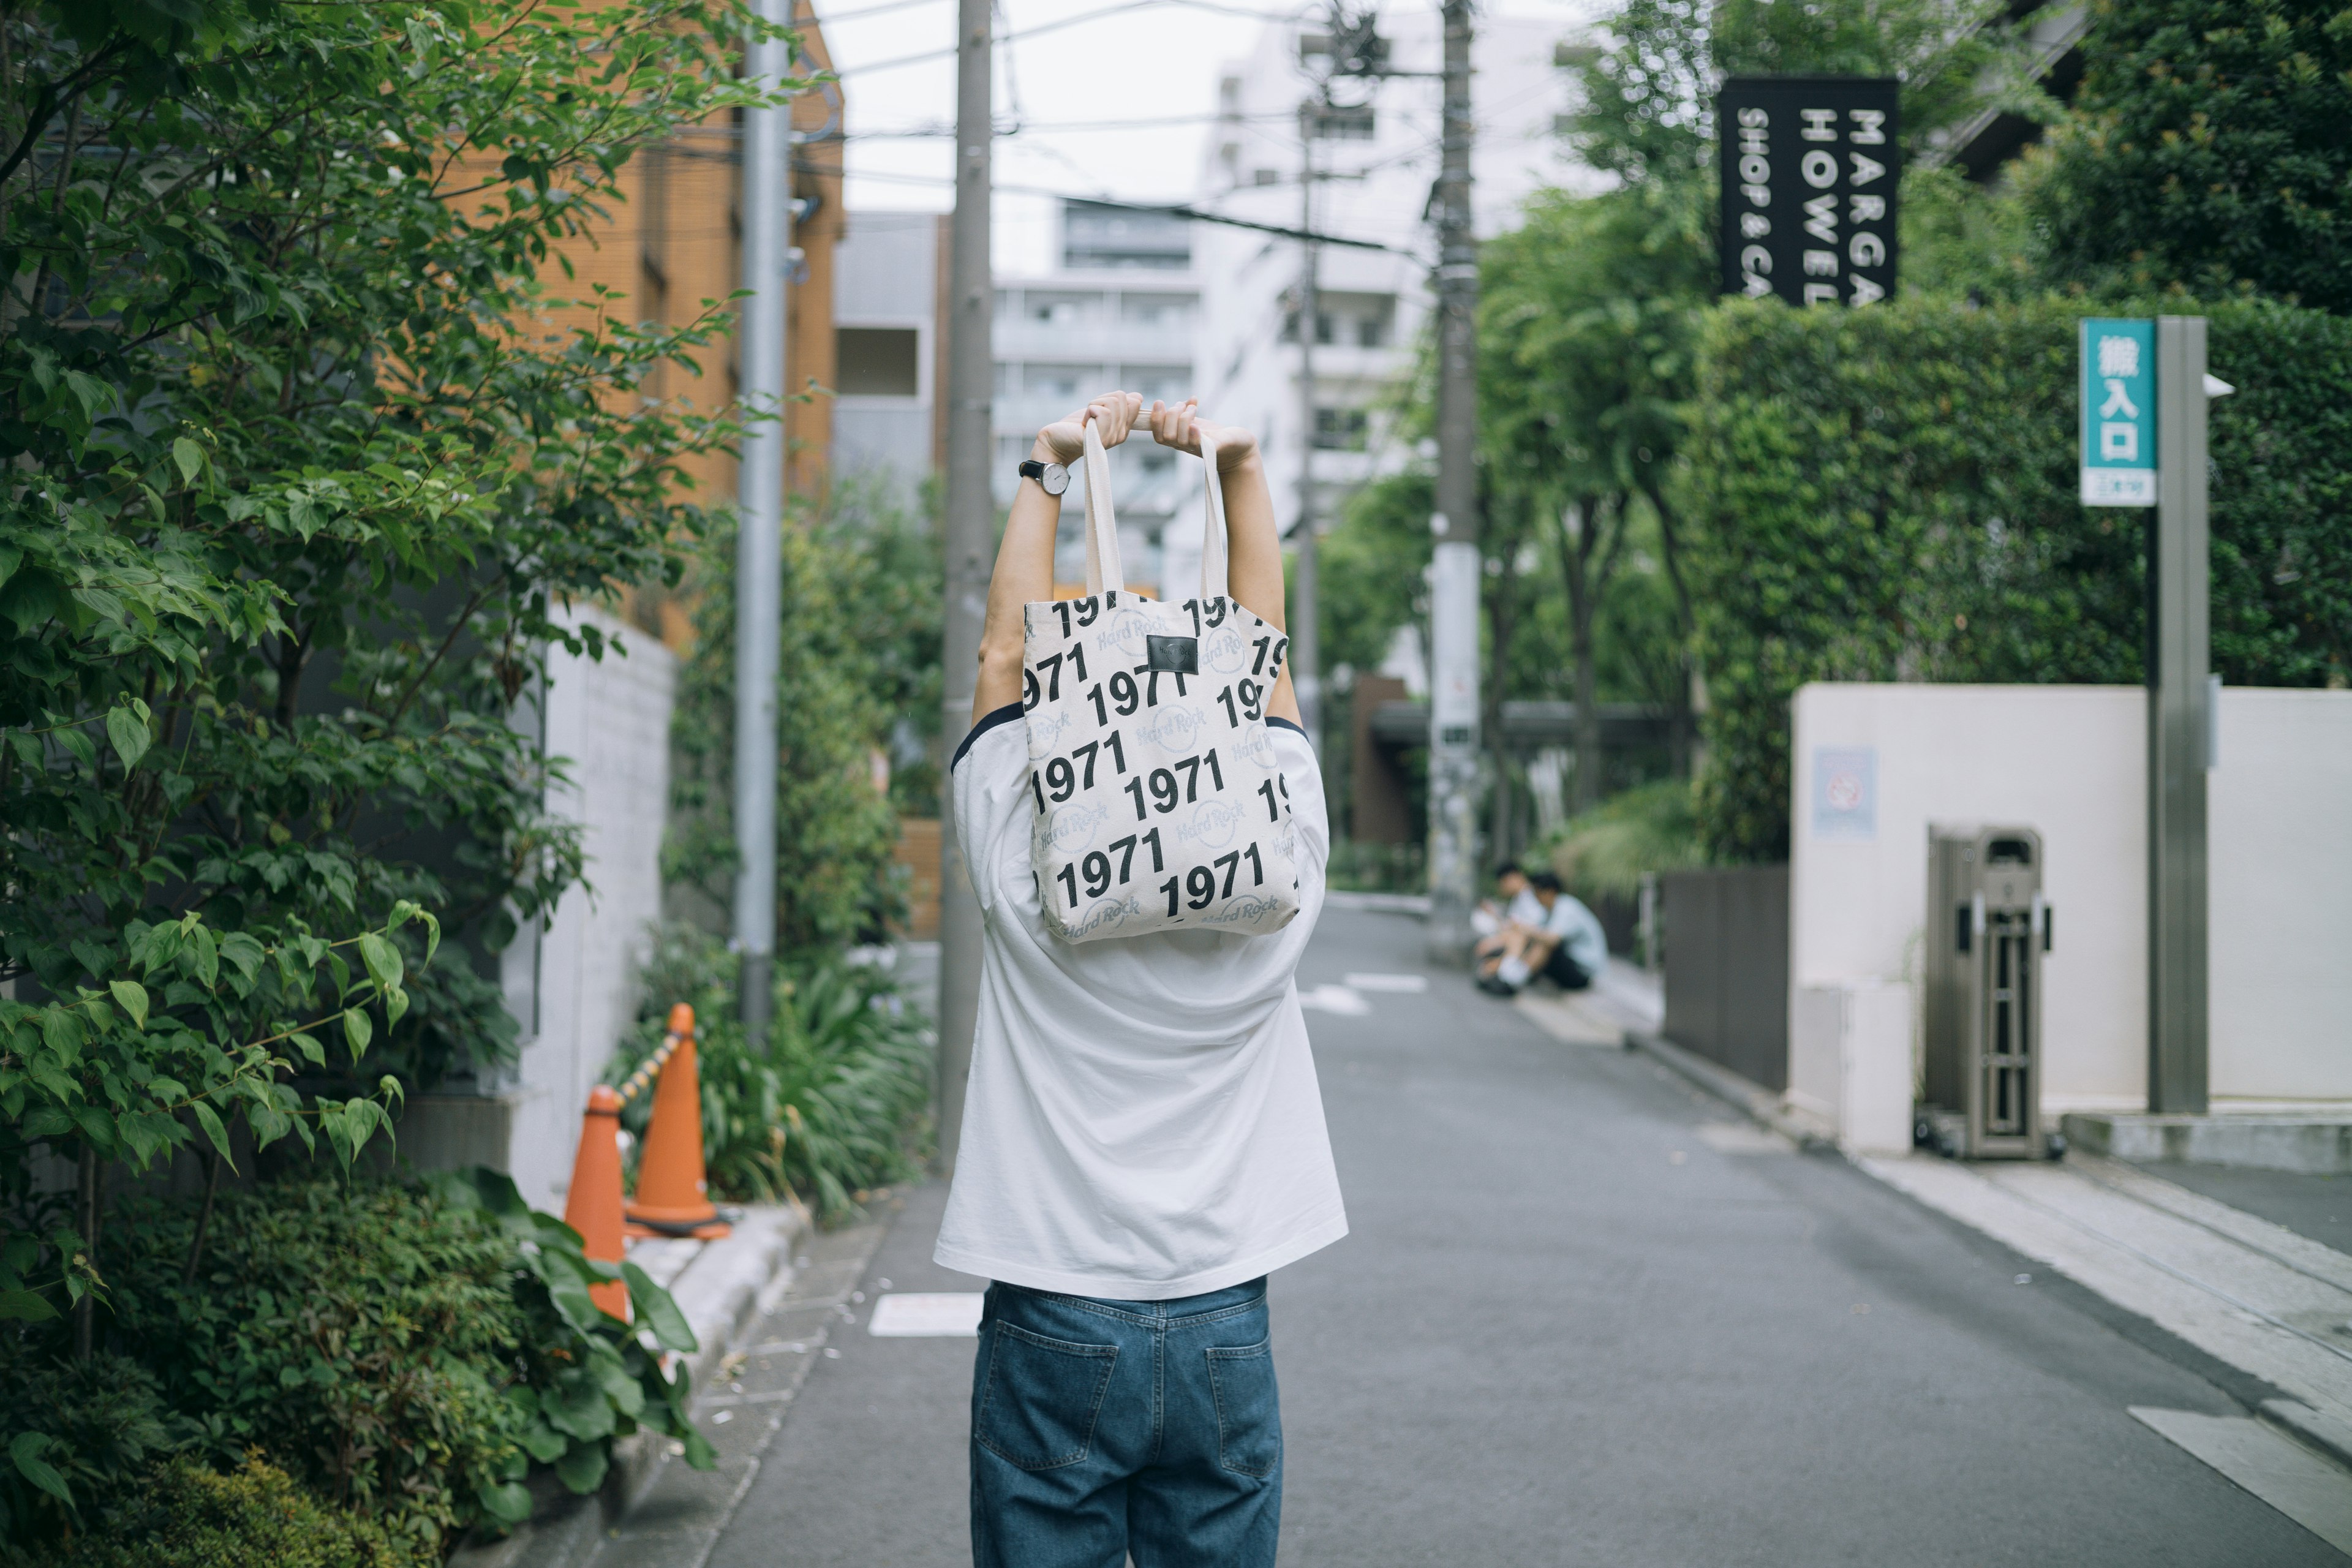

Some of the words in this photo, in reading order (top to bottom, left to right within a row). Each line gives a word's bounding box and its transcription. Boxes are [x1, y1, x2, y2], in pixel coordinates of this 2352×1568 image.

[1737, 107, 1771, 207] SHOP
[1800, 108, 1839, 306] HOWEL
[1849, 109, 1886, 309] MARGA
[1741, 244, 1773, 300] CA
[1097, 625, 1131, 650] Hard
[1131, 614, 1170, 639] Rock
[1197, 639, 1223, 668] ard
[1136, 715, 1173, 746] Hard
[1174, 707, 1207, 733] Rock
[1231, 733, 1264, 762] Hard
[1032, 729, 1126, 815] 1971
[1124, 748, 1224, 821] 1971
[1041, 816, 1069, 852] Hard
[1071, 801, 1108, 832] Rock
[1176, 813, 1212, 843] Hard
[1211, 799, 1246, 827] Rock
[1057, 827, 1164, 908] 1971
[1159, 841, 1264, 918] 1971
[1063, 912, 1099, 938] Hard
[1102, 896, 1140, 923] Rock
[1242, 895, 1278, 918] Rock
